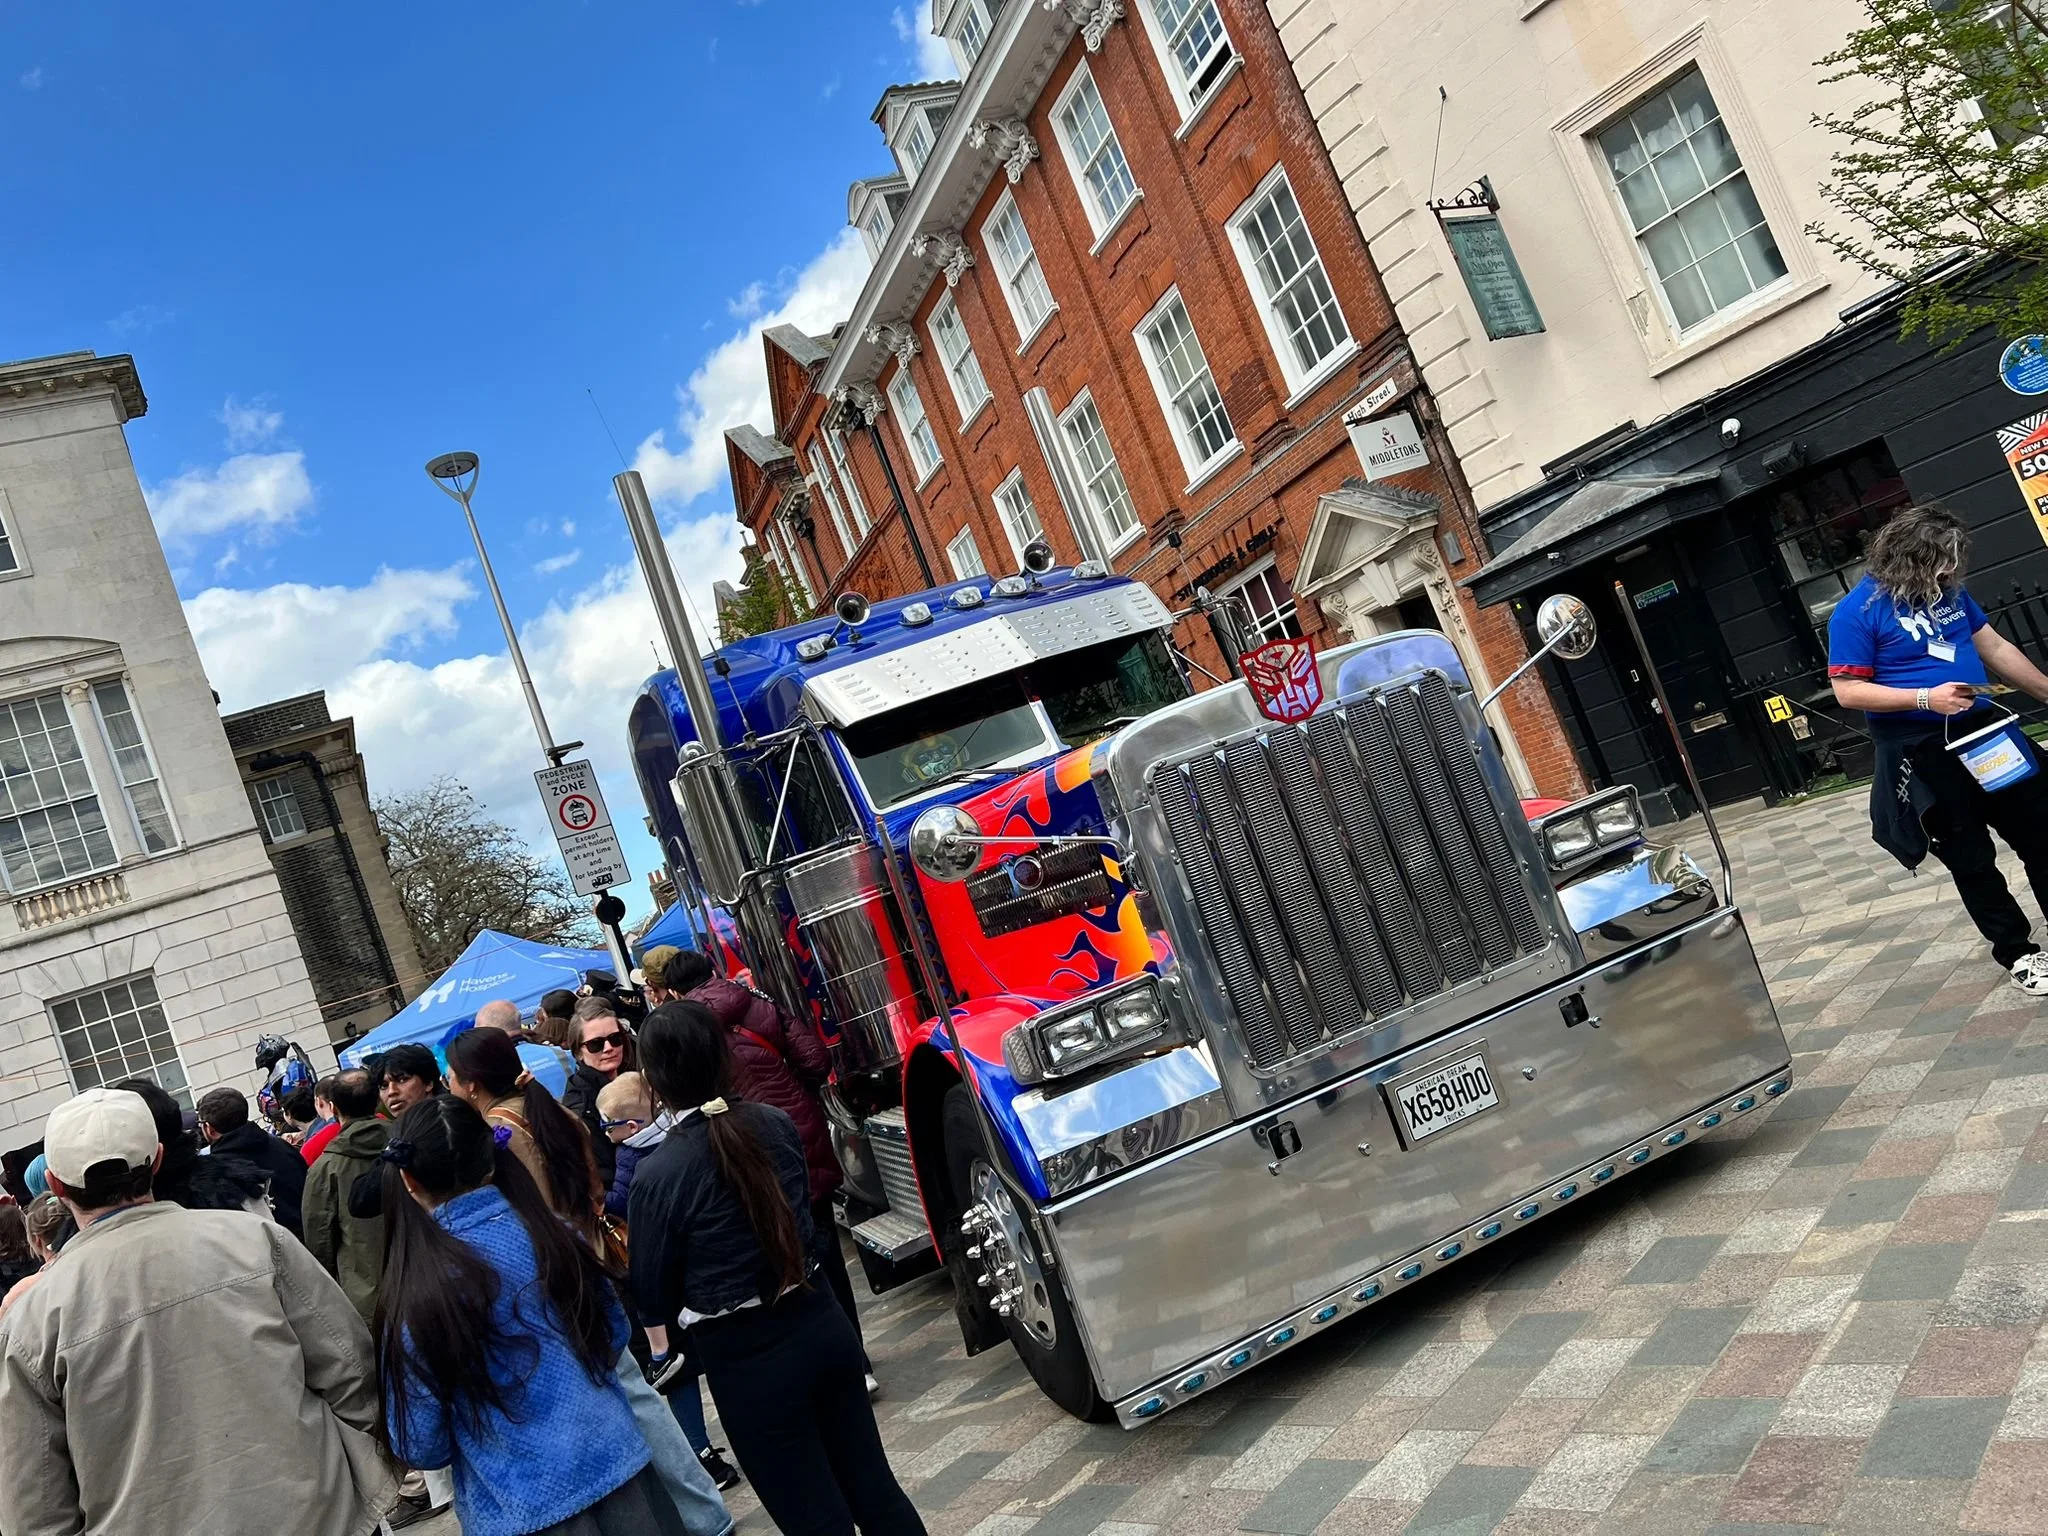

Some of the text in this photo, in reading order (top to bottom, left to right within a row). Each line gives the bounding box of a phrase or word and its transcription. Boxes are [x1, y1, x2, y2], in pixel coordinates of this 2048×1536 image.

[1347, 386, 1391, 420] High Street
[1369, 443, 1421, 466] MIDDLETONS
[2020, 441, 2041, 455] NEW
[1767, 697, 1790, 721] H
[539, 763, 587, 780] PEDESTRIAN
[547, 771, 585, 786] and CYCLE
[551, 780, 587, 797] ZONE
[564, 836, 614, 855] permit holders
[575, 832, 599, 843] Except
[582, 851, 594, 859] any
[596, 846, 611, 854] time
[590, 858, 602, 866] and
[587, 865, 612, 876] loading
[459, 974, 516, 994] Hospices
[461, 972, 508, 987] Havens
[1415, 1064, 1468, 1092] AMERICAN DREAM
[1444, 1108, 1466, 1124] TRUCKS
